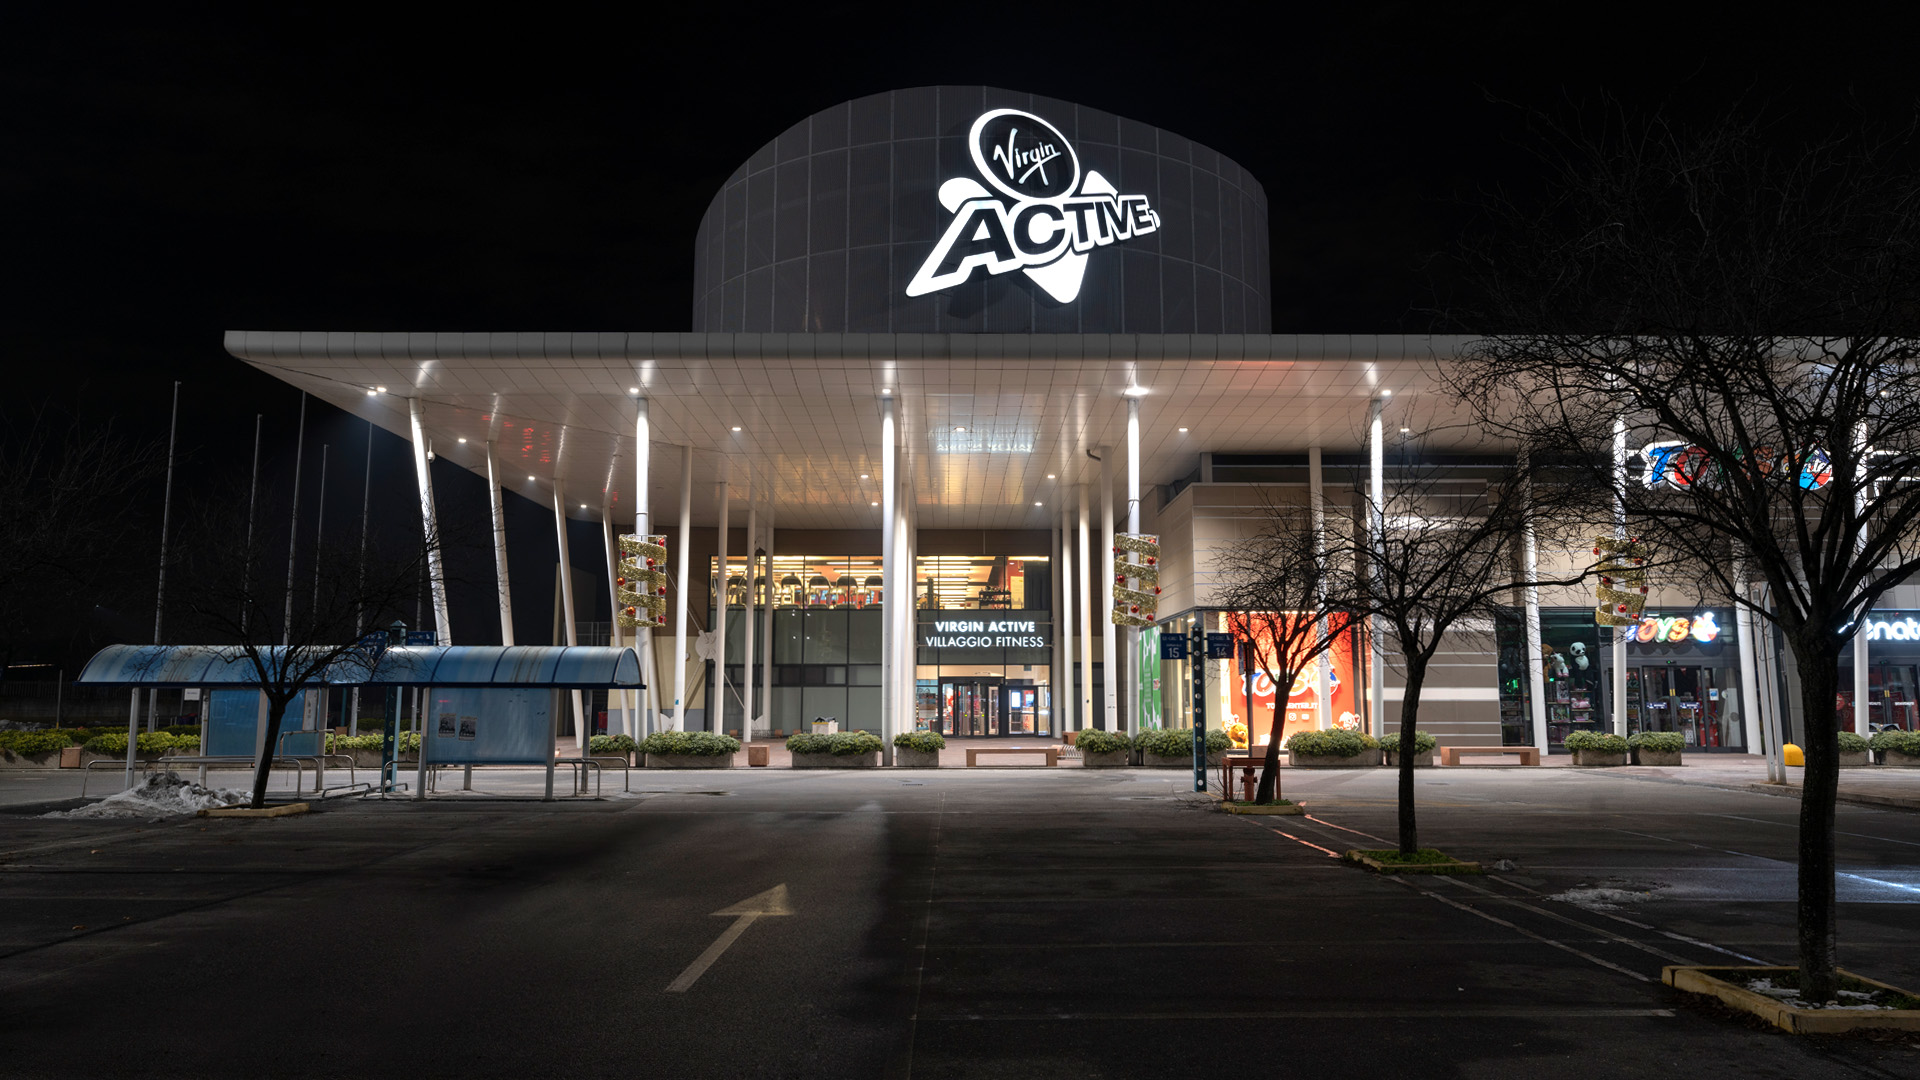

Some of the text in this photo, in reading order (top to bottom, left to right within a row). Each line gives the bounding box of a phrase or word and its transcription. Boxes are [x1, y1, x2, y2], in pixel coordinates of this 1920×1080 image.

[993, 128, 1061, 186] Virgin
[931, 198, 1154, 278] ACTIVE
[1647, 443, 1775, 486] TOS
[935, 621, 1035, 632] VIRGIN ACTIVE
[926, 636, 1044, 648] VILLAGGIO FITNESS
[1216, 647, 1227, 657] 14
[1168, 648, 1180, 658] 15
[1242, 669, 1309, 697] TOS
